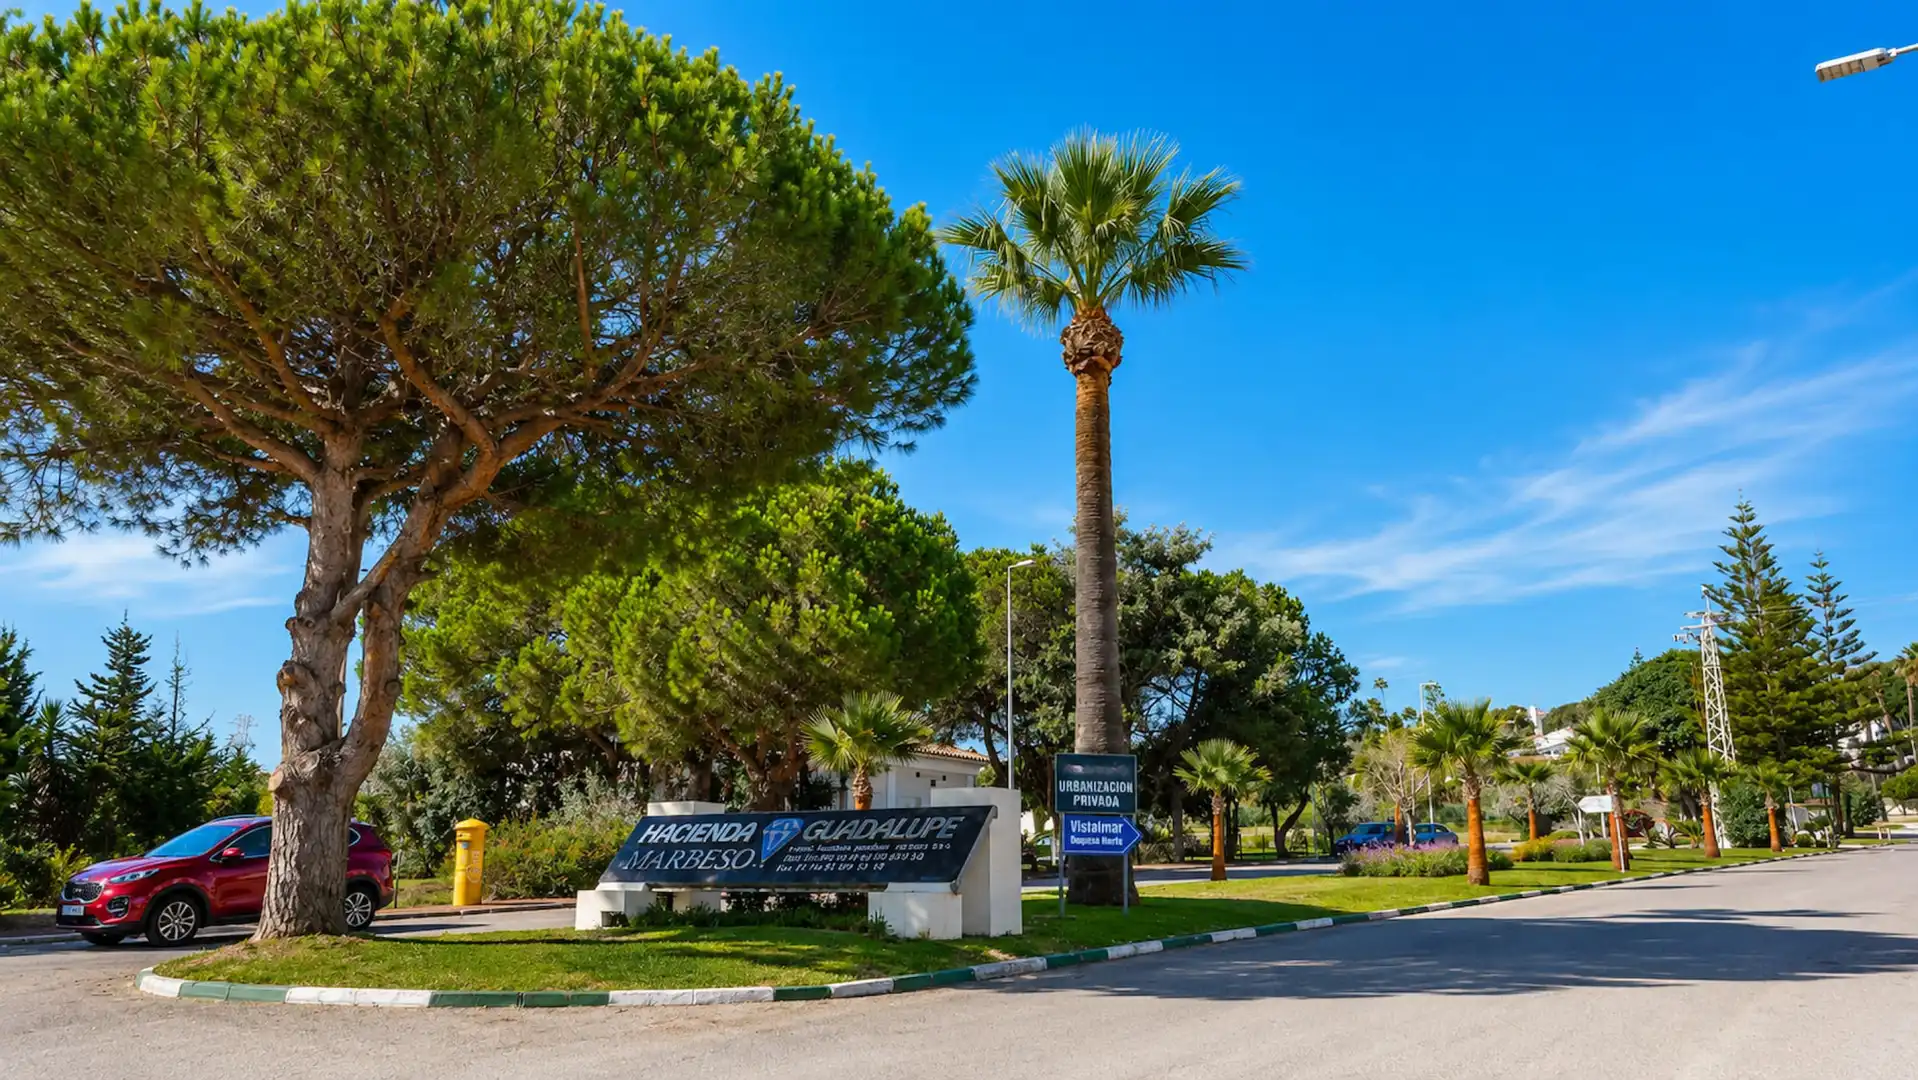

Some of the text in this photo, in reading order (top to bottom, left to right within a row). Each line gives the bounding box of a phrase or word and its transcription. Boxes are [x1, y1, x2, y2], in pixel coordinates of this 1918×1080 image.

[1059, 780, 1134, 793] URBANIZACION
[1073, 794, 1120, 808] PRIVADA
[638, 816, 966, 843] HACIENDA GUADALUPE
